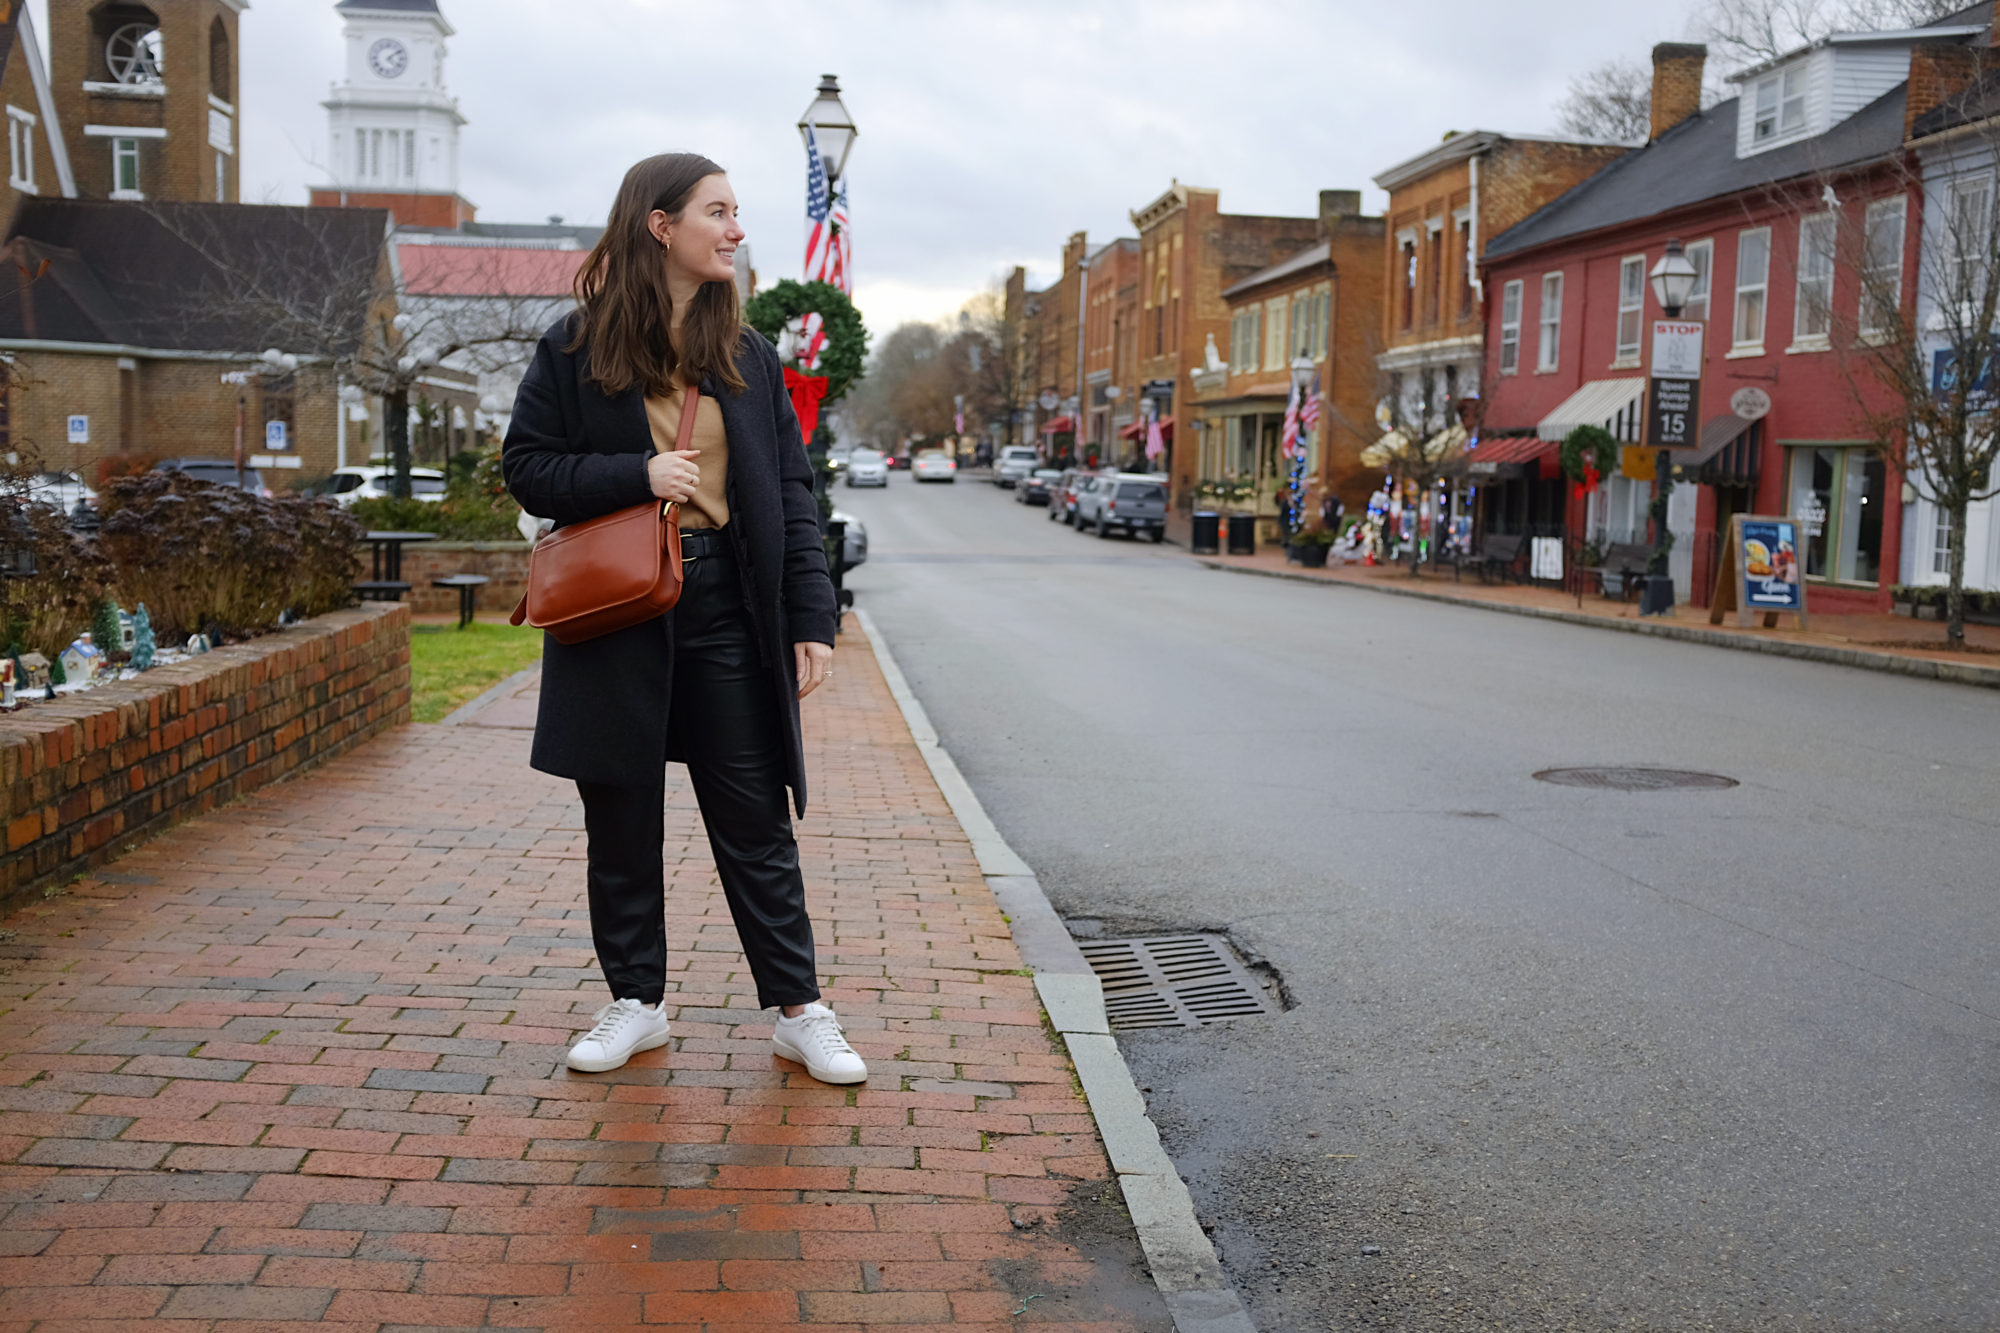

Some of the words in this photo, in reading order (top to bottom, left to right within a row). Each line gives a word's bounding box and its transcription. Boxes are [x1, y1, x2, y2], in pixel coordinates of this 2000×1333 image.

[1656, 324, 1701, 335] STOP
[1660, 380, 1690, 391] Speed
[1658, 391, 1690, 402] Humps
[1659, 400, 1689, 411] Ahead
[1661, 413, 1685, 434] 15
